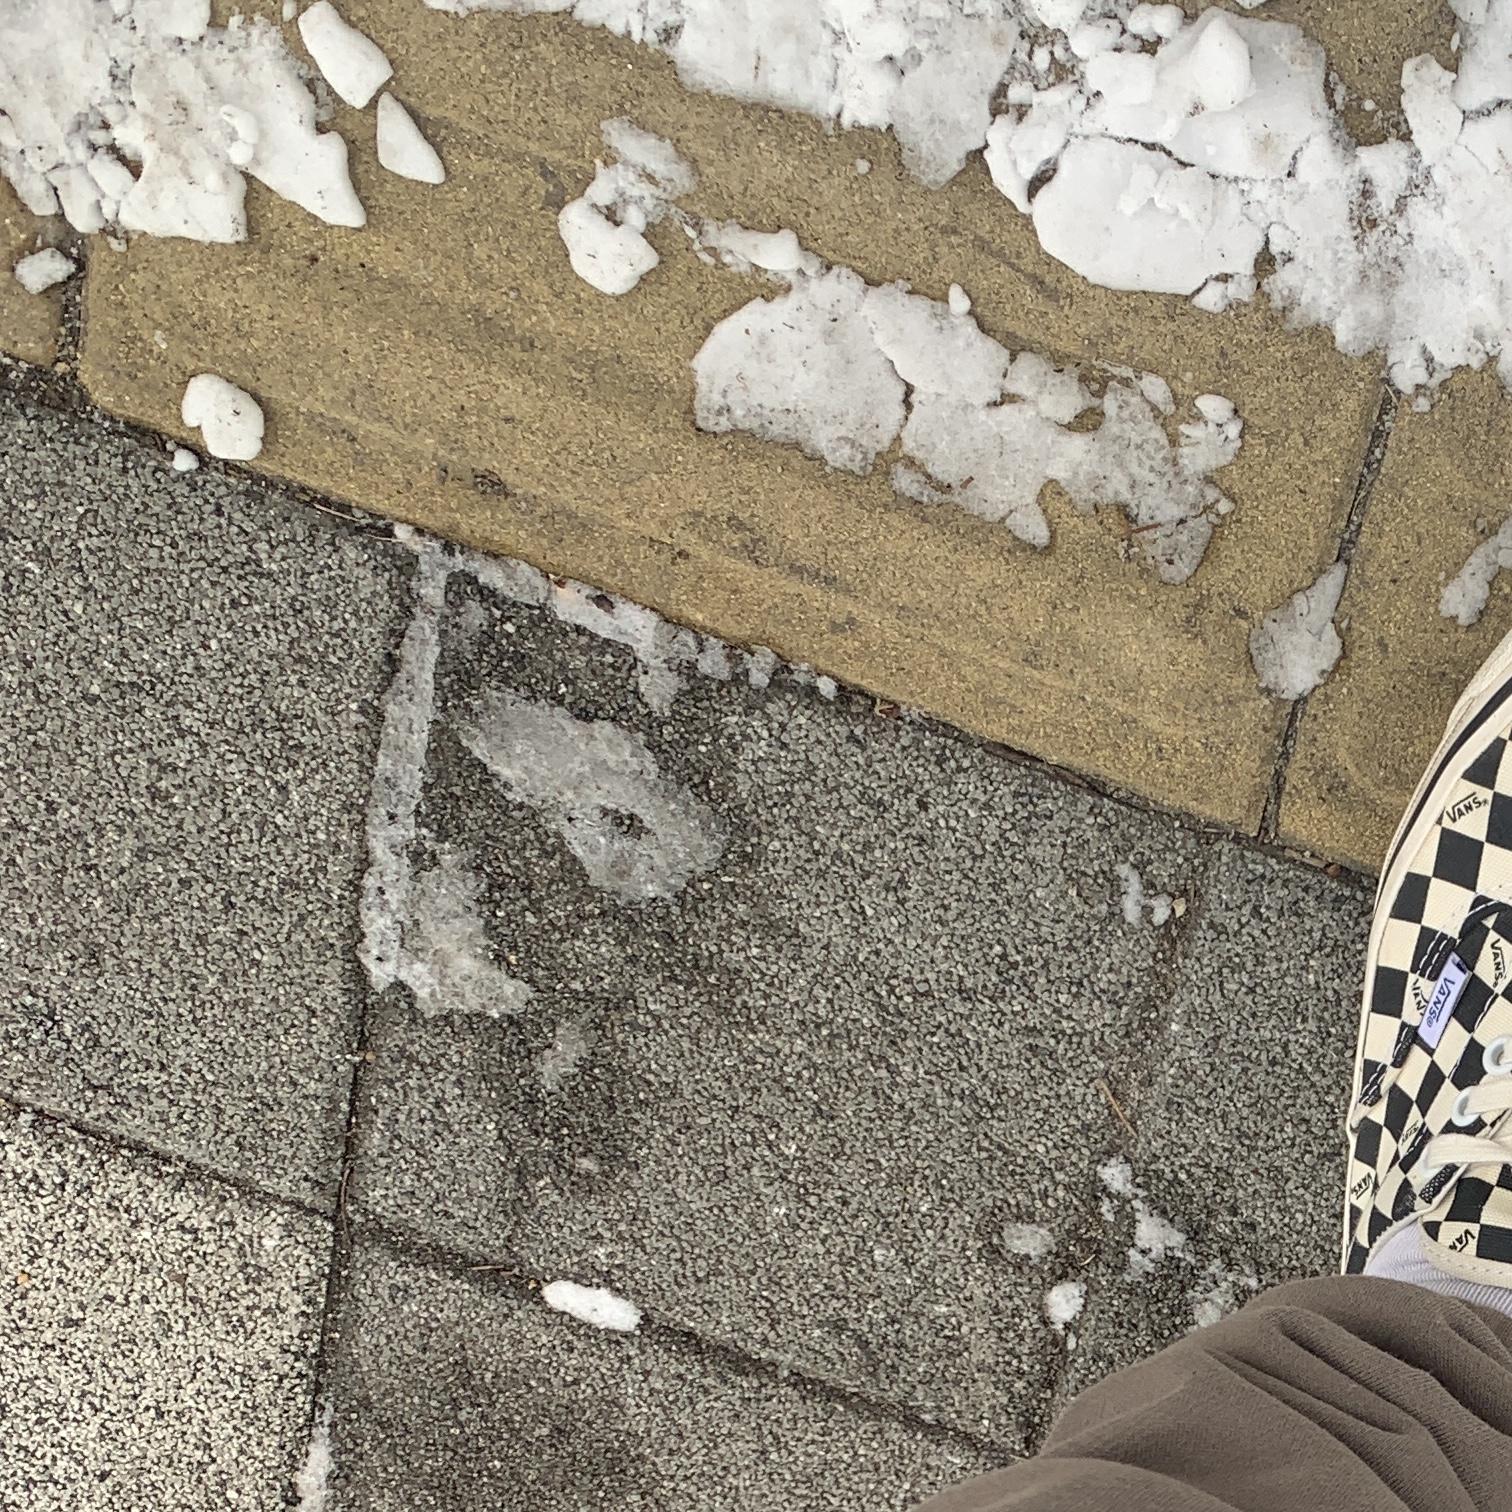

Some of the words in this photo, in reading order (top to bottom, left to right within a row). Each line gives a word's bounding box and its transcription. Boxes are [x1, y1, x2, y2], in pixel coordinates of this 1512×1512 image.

[1445, 793, 1484, 824] VANS
[1491, 938, 1506, 980] VANS
[1411, 978, 1429, 1016] VAN
[1429, 978, 1456, 1023] VANS
[1448, 1229, 1476, 1253] VAN
